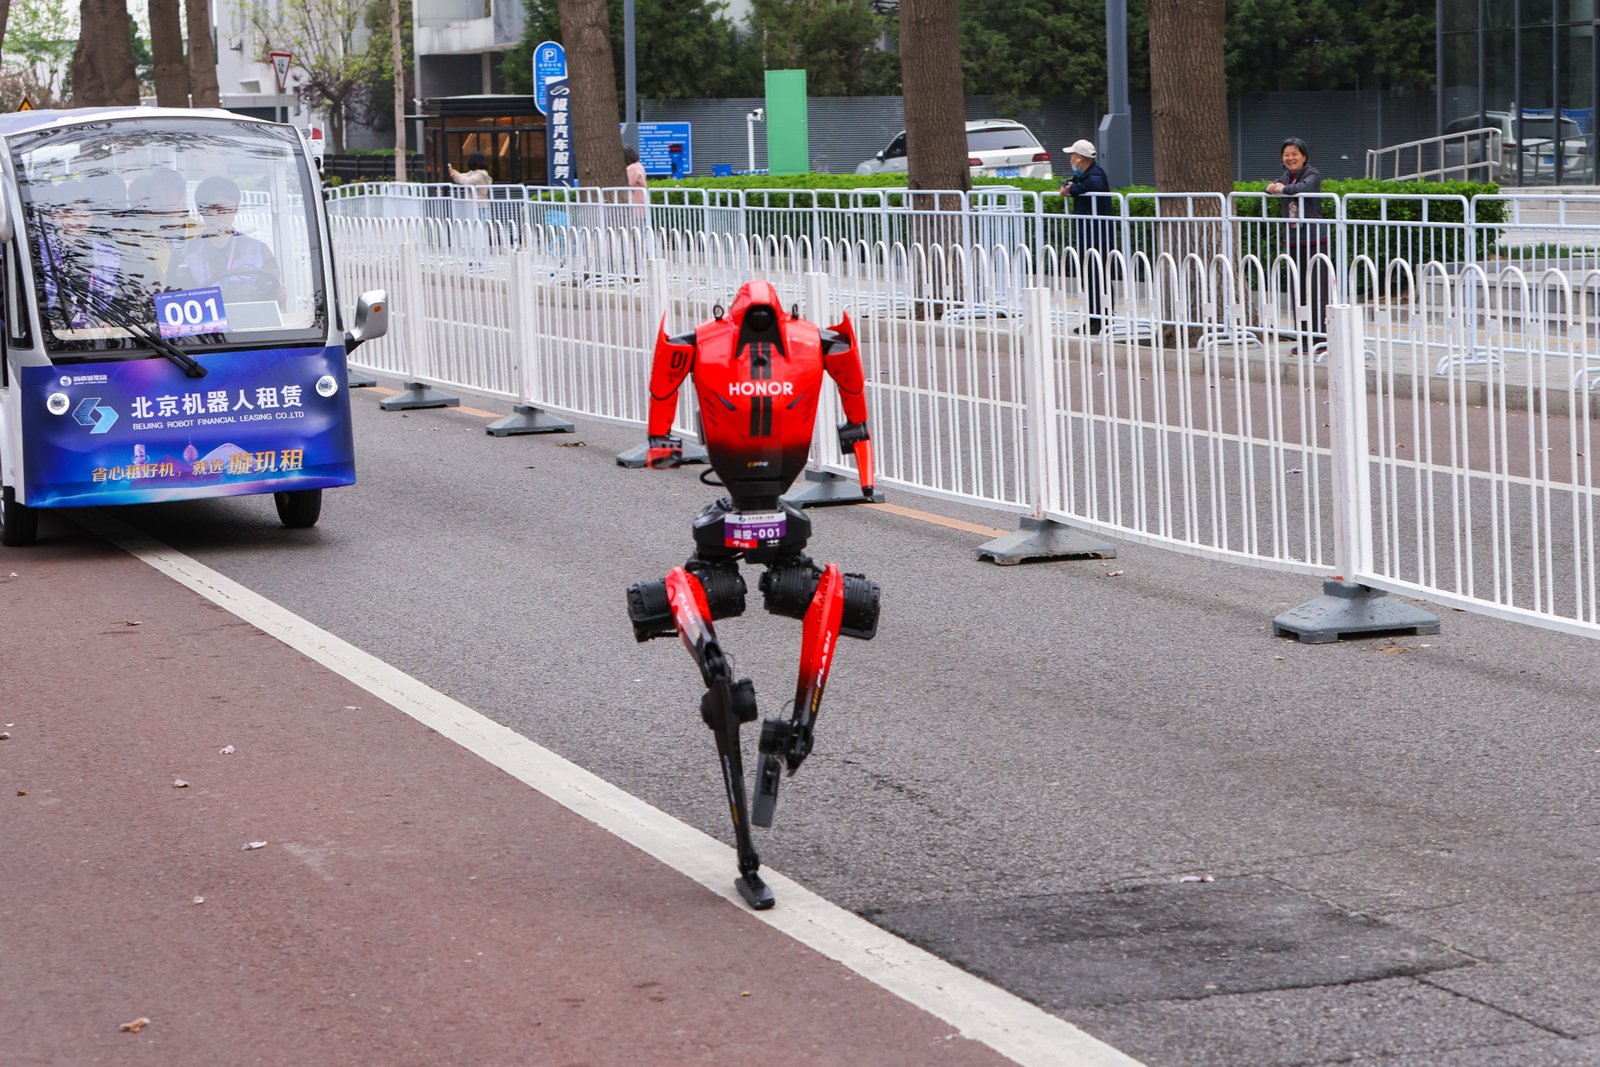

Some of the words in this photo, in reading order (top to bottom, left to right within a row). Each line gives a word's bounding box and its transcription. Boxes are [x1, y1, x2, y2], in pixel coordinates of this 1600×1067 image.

[552, 97, 570, 179] 极客汽车服务
[164, 298, 219, 327] 001
[131, 385, 303, 419] 北京机器人租赁
[728, 381, 794, 396] HONOR
[132, 422, 164, 431] BEIJING
[167, 419, 194, 428] ROBOT
[197, 416, 237, 426] FINANCIAL
[239, 413, 273, 422] LEASING
